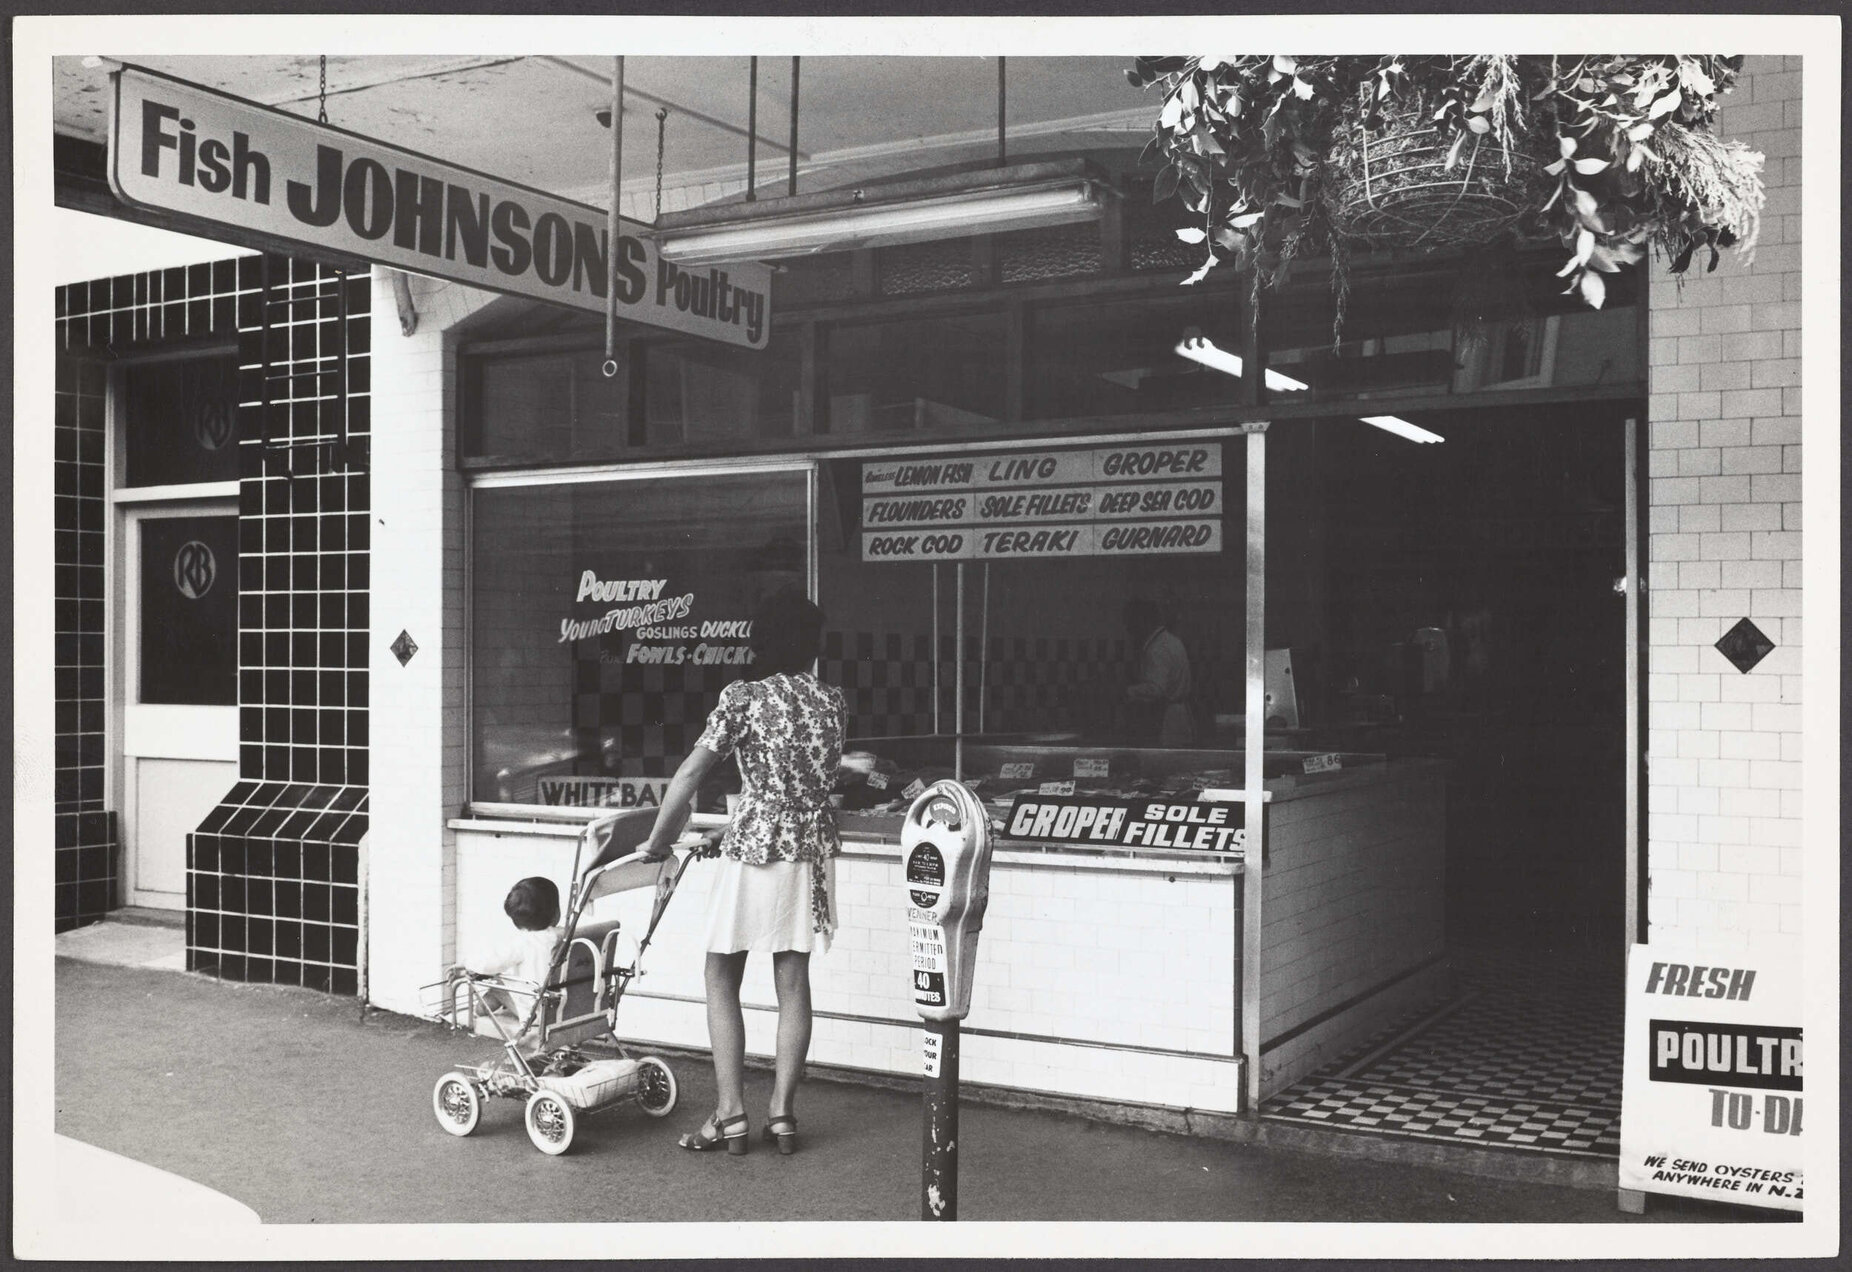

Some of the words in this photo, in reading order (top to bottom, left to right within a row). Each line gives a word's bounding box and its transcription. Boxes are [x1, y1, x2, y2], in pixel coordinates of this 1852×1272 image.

[141, 99, 271, 206] Fish
[286, 144, 647, 304] JOHNSONS
[656, 257, 765, 344] Poultry
[894, 464, 943, 486] LEMON
[941, 463, 974, 484] FISH
[988, 458, 1057, 481] LING
[1103, 450, 1208, 476] GROPER
[868, 498, 966, 522] FLOUNDERS
[980, 495, 1026, 518] SOLE
[1025, 493, 1092, 516] FILLETS
[1099, 492, 1141, 514] DEEP
[1140, 490, 1173, 512] SEA
[1174, 488, 1215, 511] COD
[868, 536, 919, 555] ROCK
[921, 534, 963, 553] COD
[983, 530, 1079, 553] TERAKI
[1101, 524, 1212, 550] GURNARD
[576, 570, 667, 602] POULTRY
[558, 618, 605, 643] YOUNG
[604, 593, 694, 633] TURKEYS
[636, 626, 697, 640] GOSLINGS
[1009, 803, 1128, 840] GROPER
[1144, 804, 1229, 824] SOLE
[1123, 821, 1246, 851] FILLETS
[916, 972, 930, 990] 40
[1645, 962, 1757, 1001] FRESH
[924, 1037, 937, 1047] OCK
[1657, 1030, 1803, 1077] POULTR
[1644, 1156, 1667, 1168] WE
[1672, 1159, 1707, 1173] SEND
[1714, 1164, 1794, 1183] OYSTERS
[1652, 1170, 1740, 1191] ANYWHERE
[1746, 1181, 1763, 1193] IN
